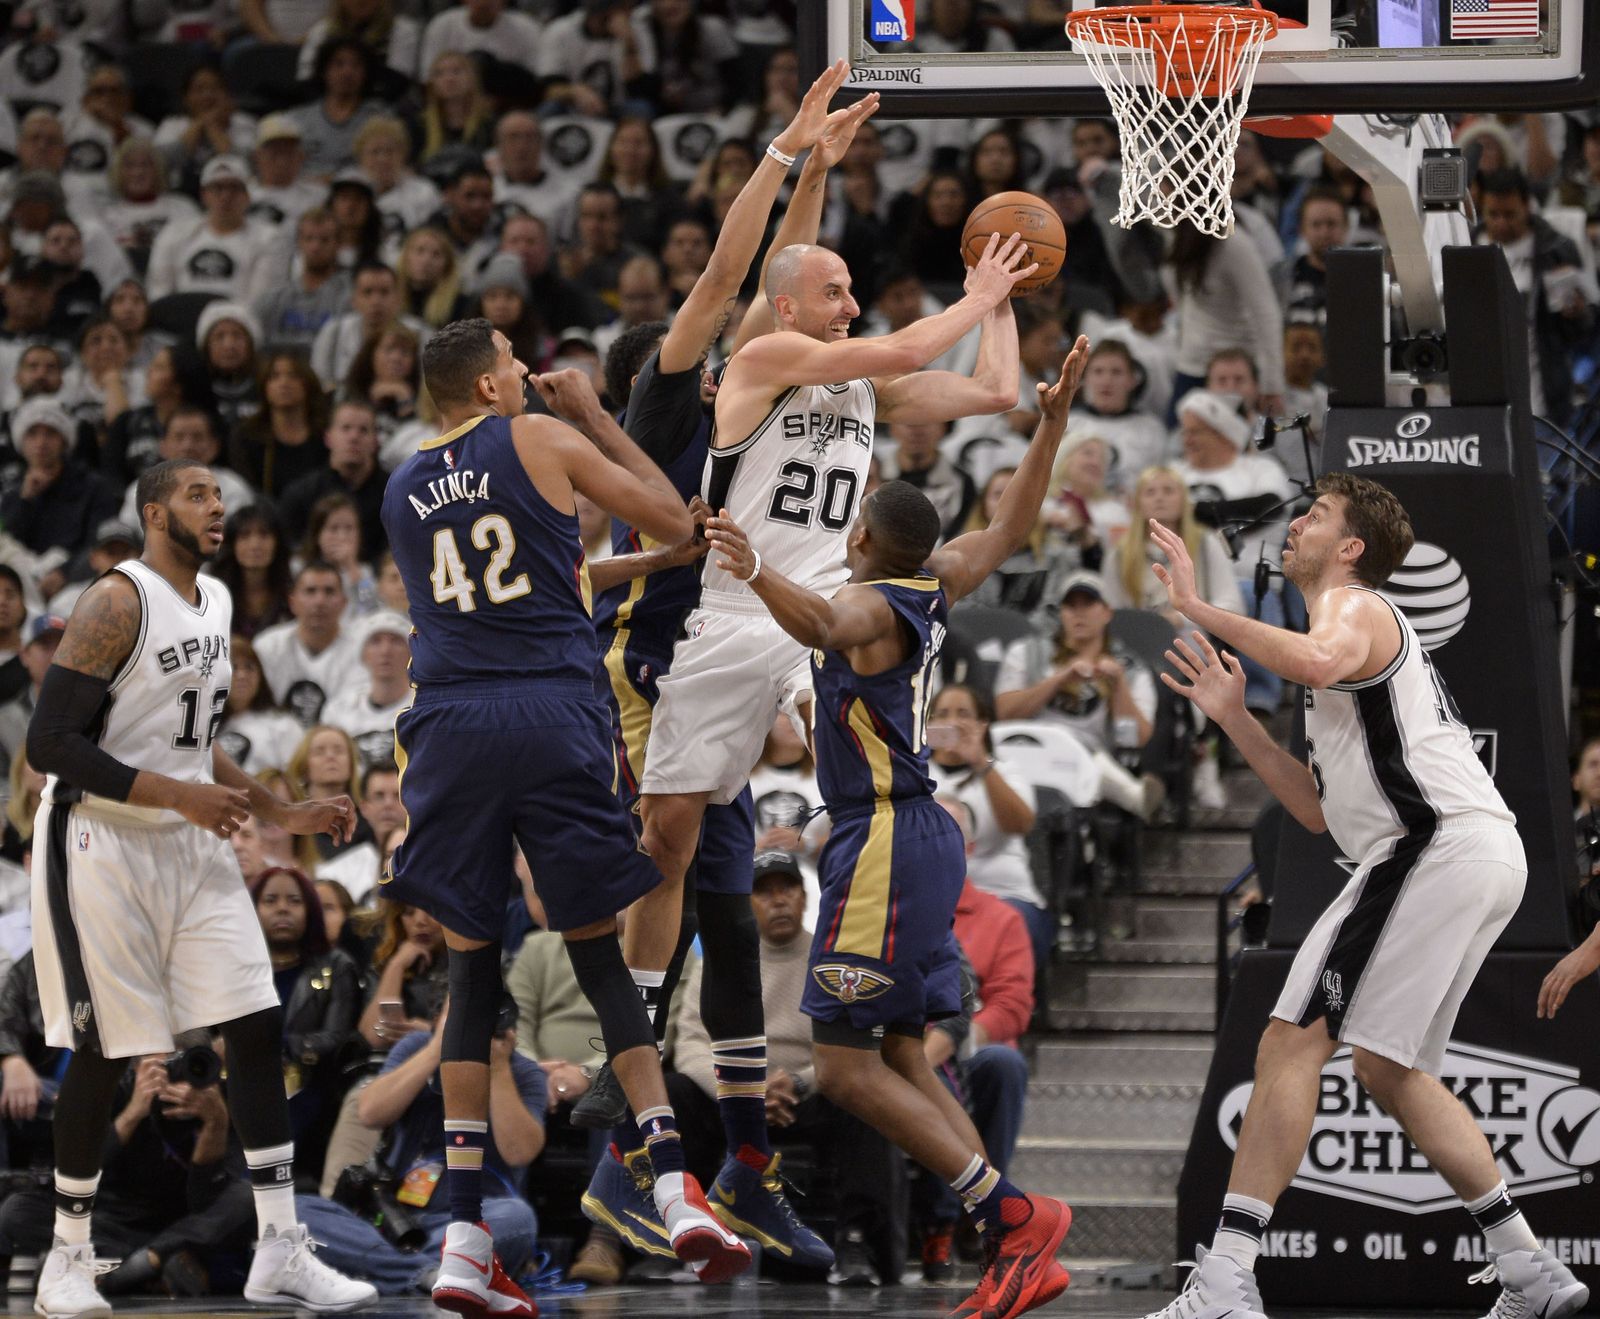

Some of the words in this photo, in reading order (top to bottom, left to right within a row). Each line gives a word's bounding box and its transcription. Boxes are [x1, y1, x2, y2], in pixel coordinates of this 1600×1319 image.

[875, 21, 901, 36] NBA
[849, 67, 922, 84] SPALDING
[1347, 435, 1482, 467] SPALDING
[408, 470, 490, 521] AJINÇA
[765, 457, 860, 534] 20
[430, 514, 532, 613] 42
[1308, 1129, 1525, 1177] CHEK
[1364, 1232, 1407, 1260] OIL
